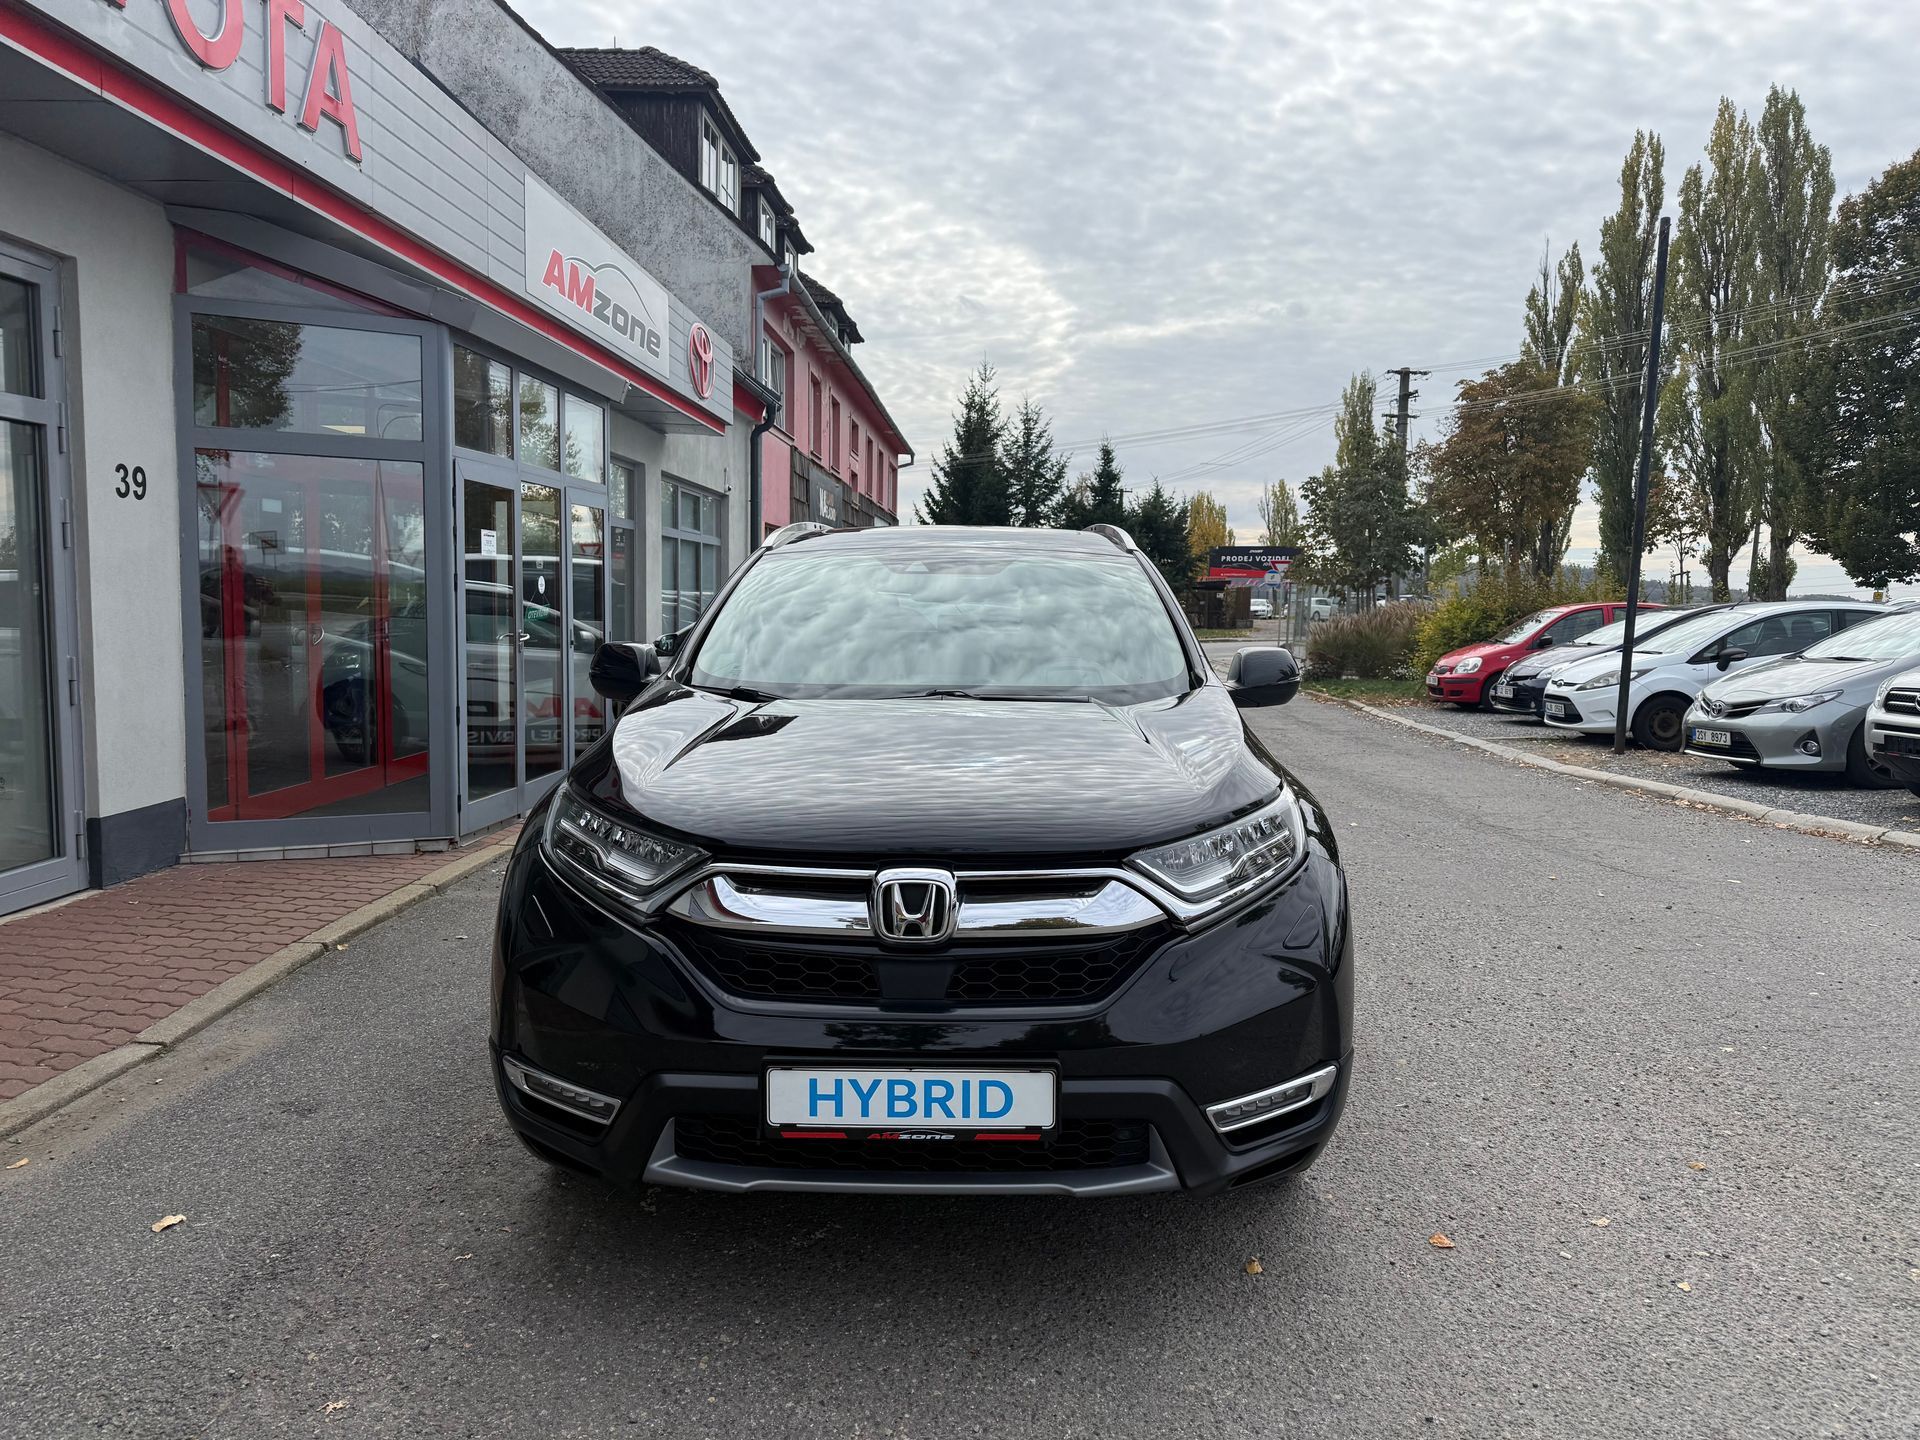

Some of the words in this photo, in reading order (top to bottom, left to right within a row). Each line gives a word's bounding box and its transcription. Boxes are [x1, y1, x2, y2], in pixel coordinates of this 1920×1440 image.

[541, 248, 662, 360] AMzone
[115, 463, 147, 501] 39
[1710, 731, 1728, 743] 8973
[808, 1078, 1014, 1119] HYBRID
[867, 1132, 956, 1140] AMzone
